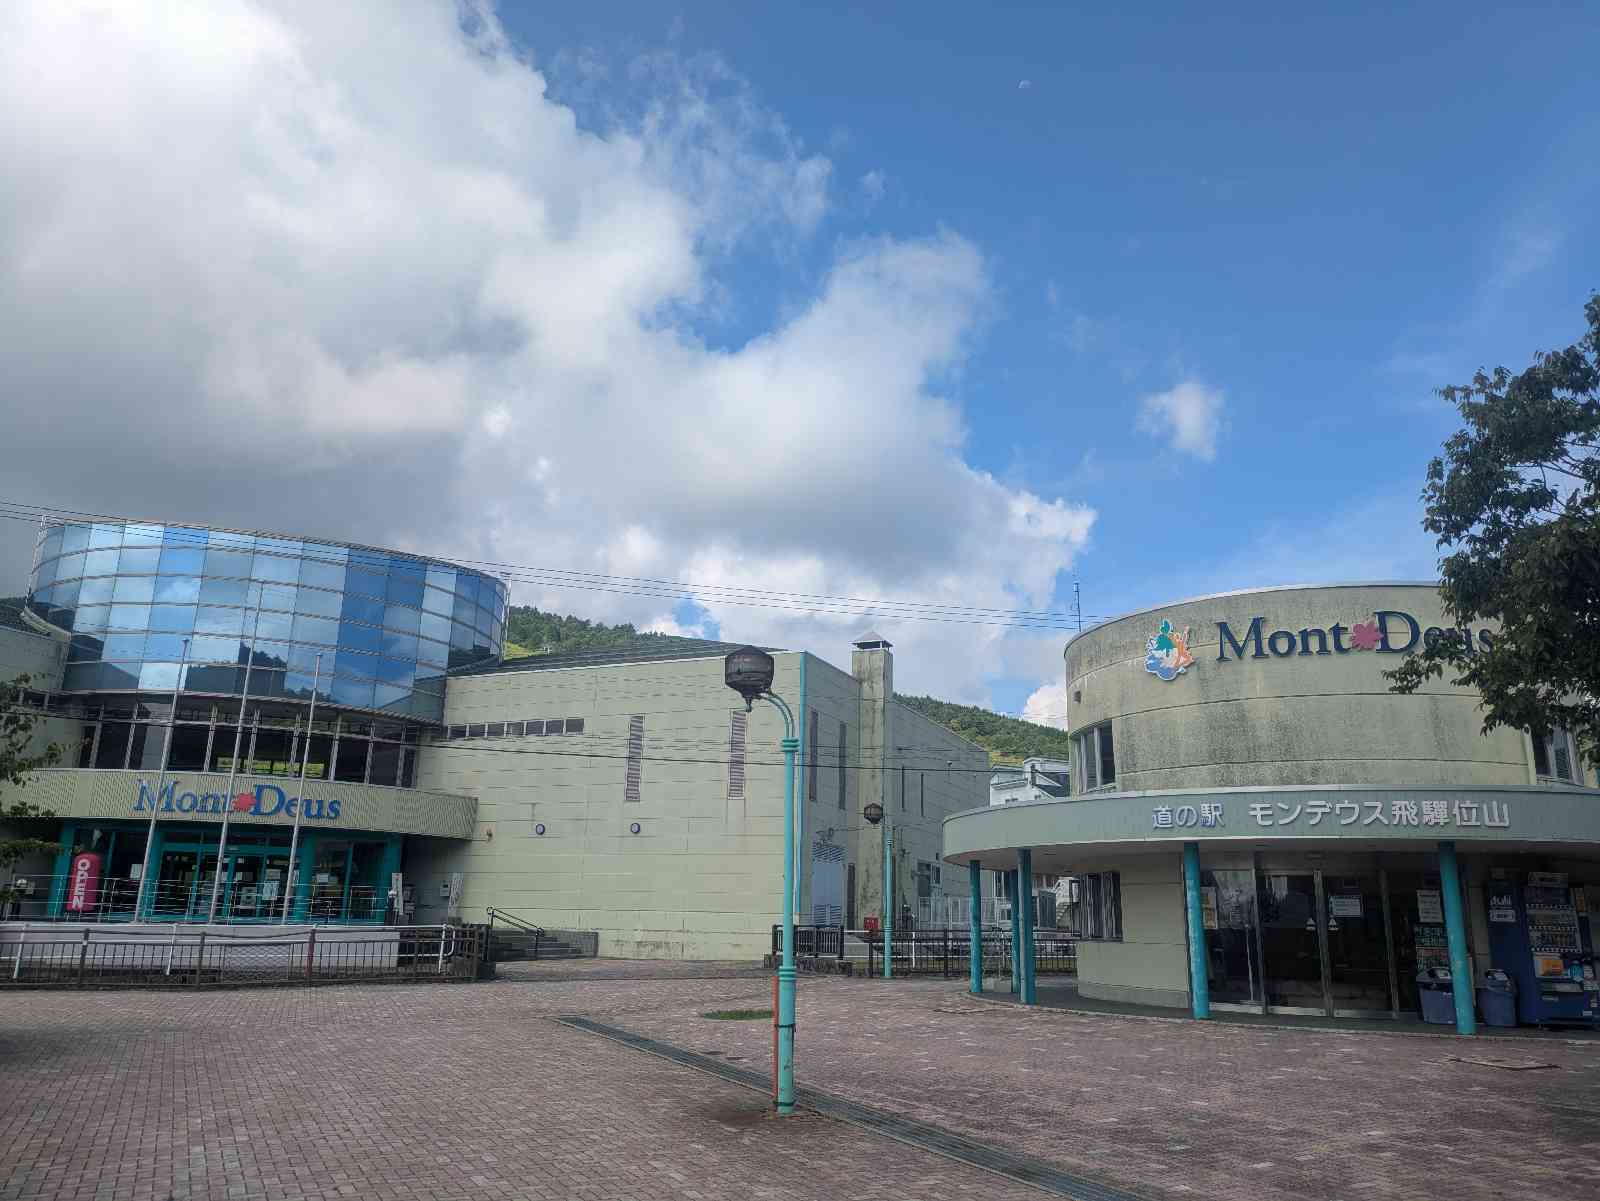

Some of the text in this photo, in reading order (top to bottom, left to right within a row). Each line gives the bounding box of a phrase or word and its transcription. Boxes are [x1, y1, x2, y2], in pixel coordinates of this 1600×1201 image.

[1215, 616, 1350, 662] Mont
[250, 784, 341, 819] Deus
[1151, 801, 1225, 829] 道の駅
[71, 858, 92, 910] OPEN
